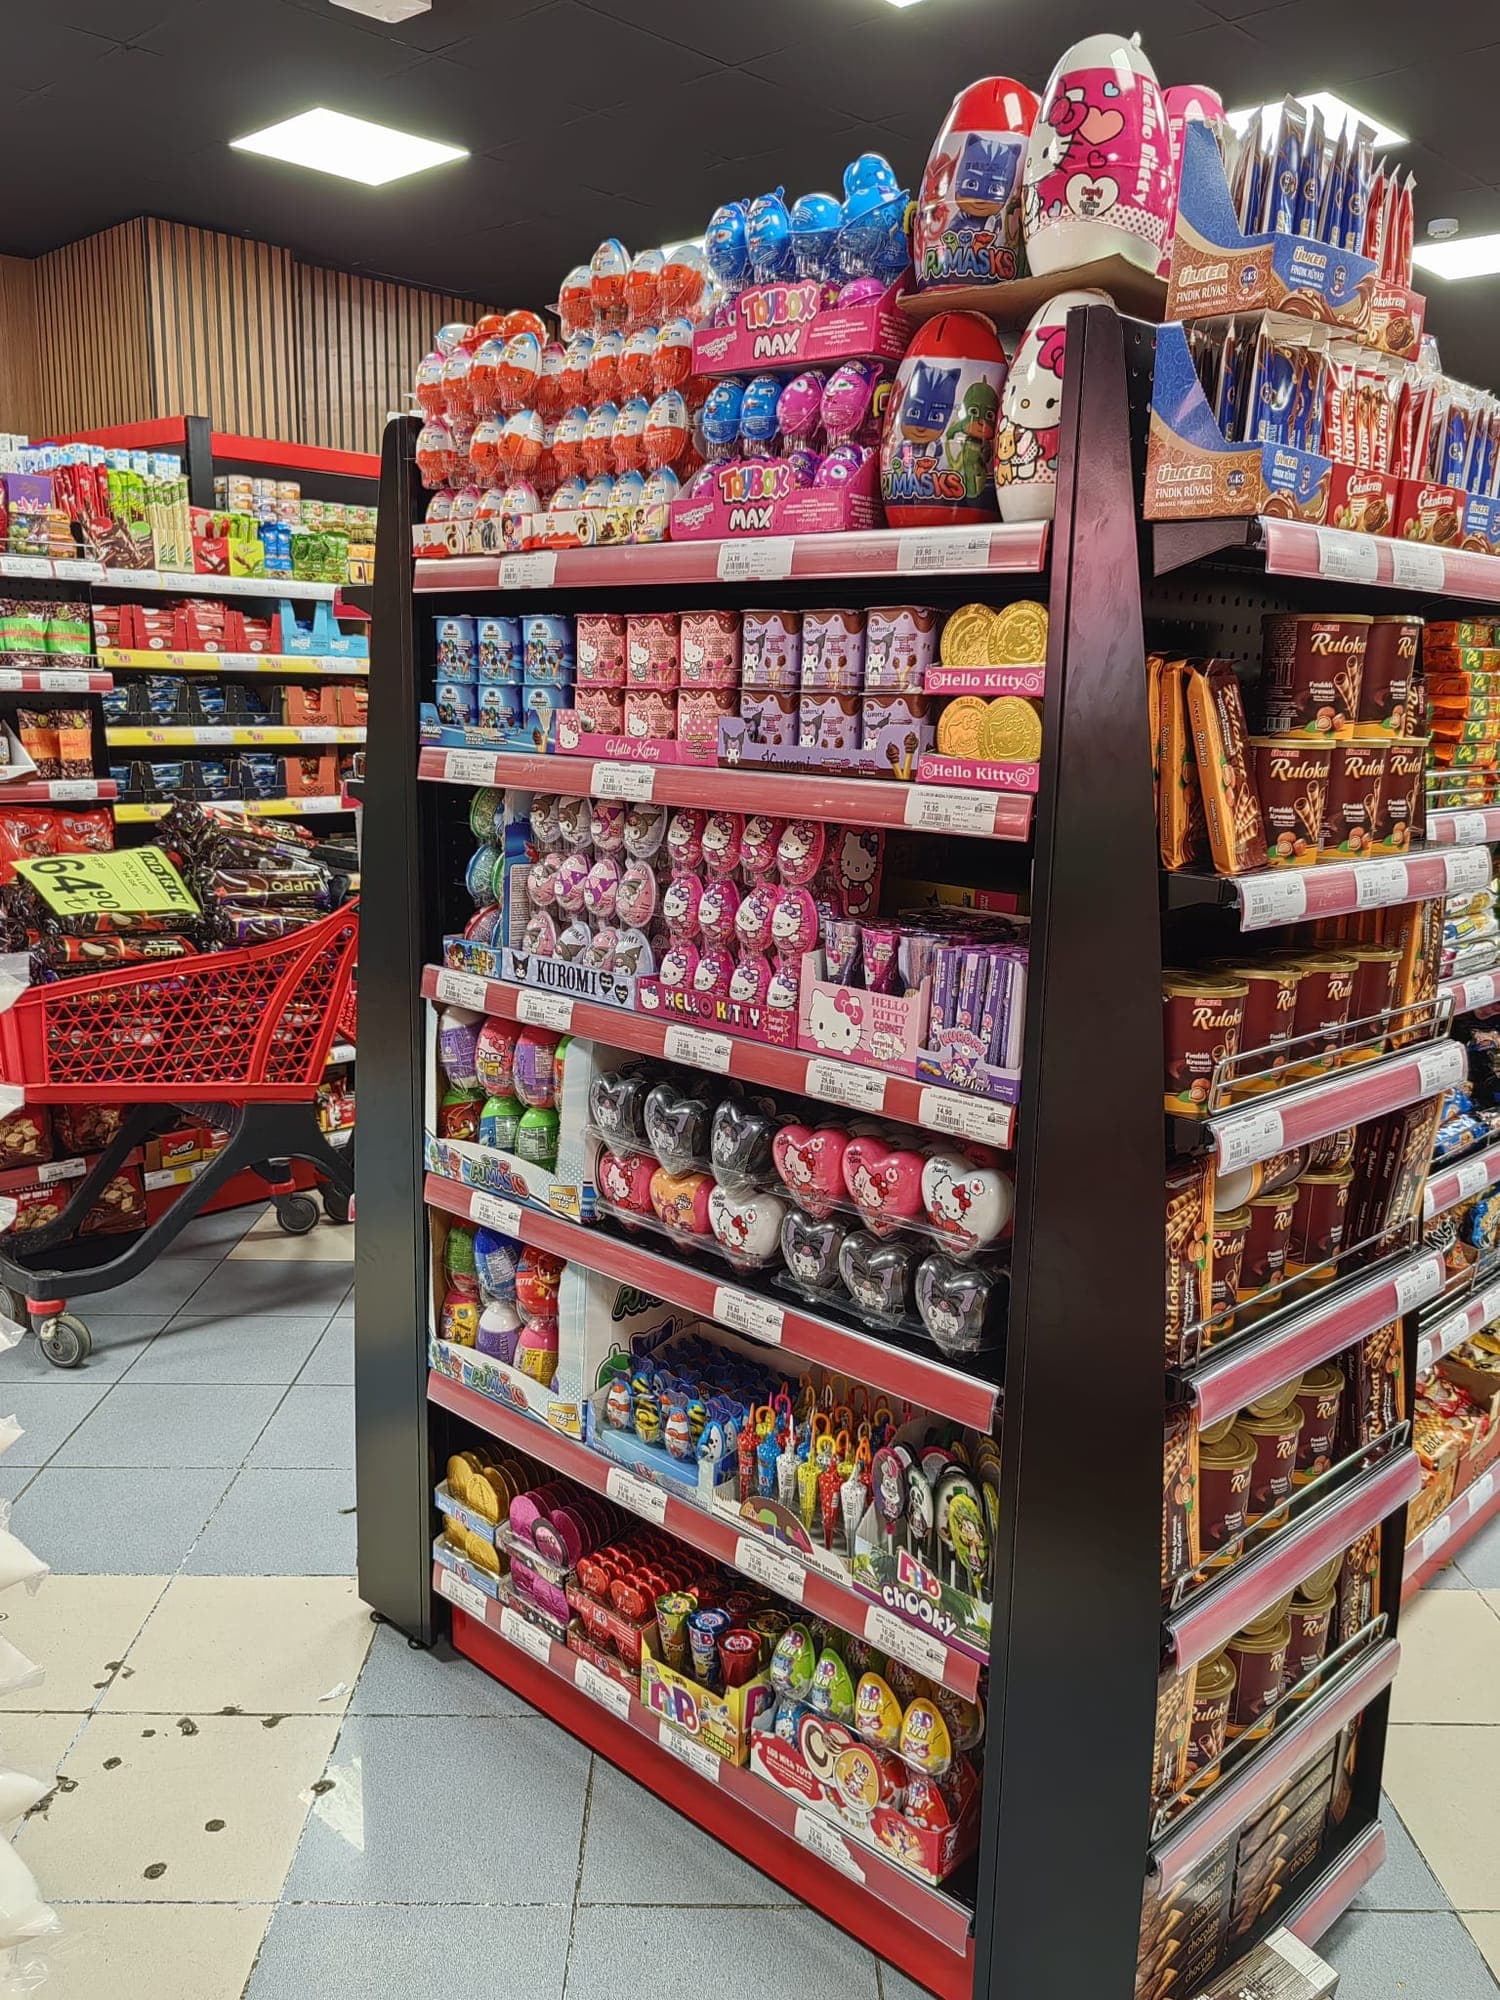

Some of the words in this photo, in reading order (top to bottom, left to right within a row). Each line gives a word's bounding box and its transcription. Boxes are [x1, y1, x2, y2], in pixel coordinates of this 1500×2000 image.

[1142, 80, 1157, 139] Hello
[1132, 143, 1159, 206] Kitty
[1292, 246, 1327, 268] ÜLKER
[1179, 262, 1229, 287] ÜLKER
[741, 285, 819, 329] TOYBOX
[753, 330, 799, 359] MAX
[720, 464, 790, 503] TOYBOX
[1157, 463, 1212, 484] ÜLKER
[729, 505, 774, 531] MAX
[940, 672, 980, 687] Hello
[984, 673, 1024, 690] Kitty
[1223, 684, 1248, 779] Rulokat
[605, 738, 632, 758] Hello
[632, 740, 660, 760] Kitty
[1197, 730, 1207, 769] Rulokat
[1271, 749, 1299, 758] ÜLKER
[932, 763, 972, 779] Hello
[976, 766, 1016, 783] Kitty
[1270, 758, 1329, 781] Ruloka
[1344, 756, 1384, 779] Rulok
[1390, 755, 1421, 776] Rulo
[30, 859, 105, 895] 64
[88, 890, 121, 909] 90
[271, 880, 323, 893] LUPPO
[143, 947, 185, 958] LUPPO
[537, 959, 597, 995] KUROMI
[664, 987, 713, 1019] HELLO
[716, 1000, 761, 1030] KITTY
[871, 996, 909, 1013] HELLO
[872, 1008, 908, 1025] KITTY
[873, 1020, 904, 1036] CORNET
[1192, 1008, 1243, 1030] Rulok
[1165, 1256, 1181, 1346] Rulokat
[1369, 1371, 1382, 1443] Rulokat
[701, 1727, 736, 1753] SURPRISE
[1190, 1889, 1223, 1926] chocolate
[1187, 1918, 1220, 1953] chocolate
[1184, 1947, 1217, 1984] chocolate
